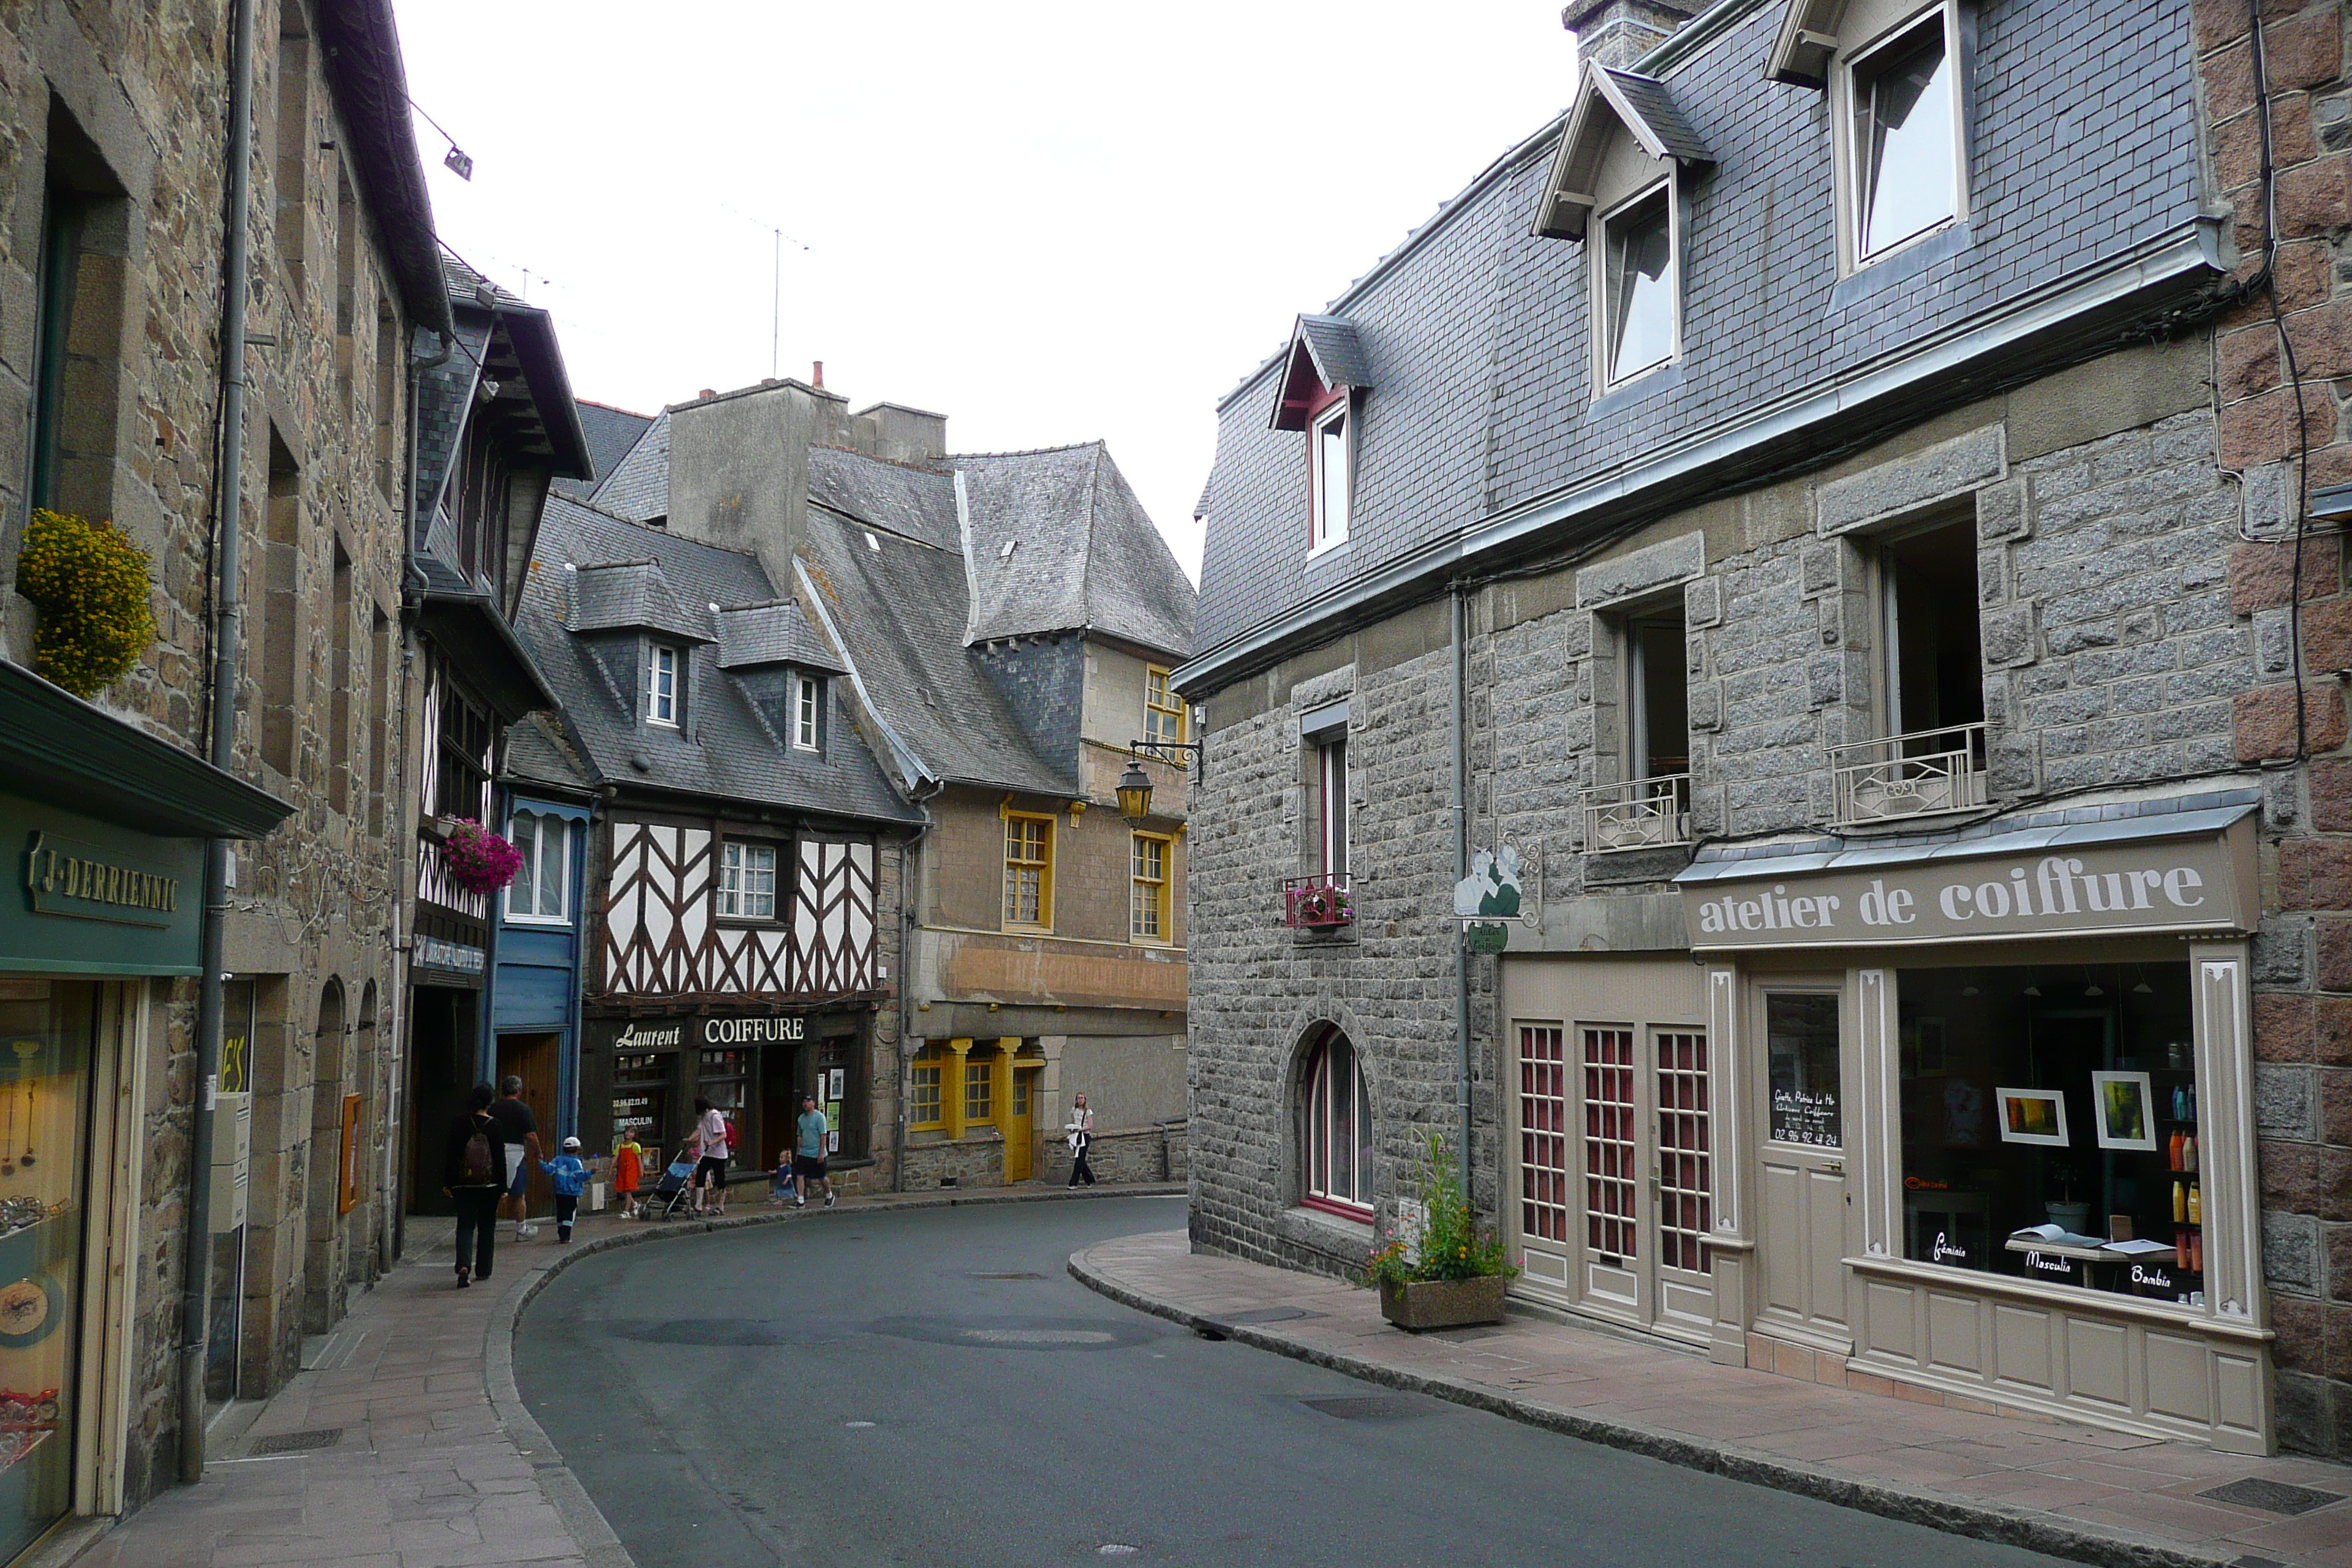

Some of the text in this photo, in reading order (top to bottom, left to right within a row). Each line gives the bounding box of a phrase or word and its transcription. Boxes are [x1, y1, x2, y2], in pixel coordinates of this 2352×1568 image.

[64, 857, 178, 912] DERRIENNIC
[1700, 856, 2204, 932] atelier de coiffure
[616, 1018, 804, 1047] Laurent COIFFURE
[619, 1117, 652, 1126] MASCULIN
[1775, 1128, 1785, 1139] 02
[1788, 1130, 1798, 1142] 96
[1802, 1131, 1812, 1143] 92
[1825, 1134, 1836, 1146] 24
[2027, 1251, 2070, 1273] Masculin
[2131, 1265, 2170, 1288] Bambin
